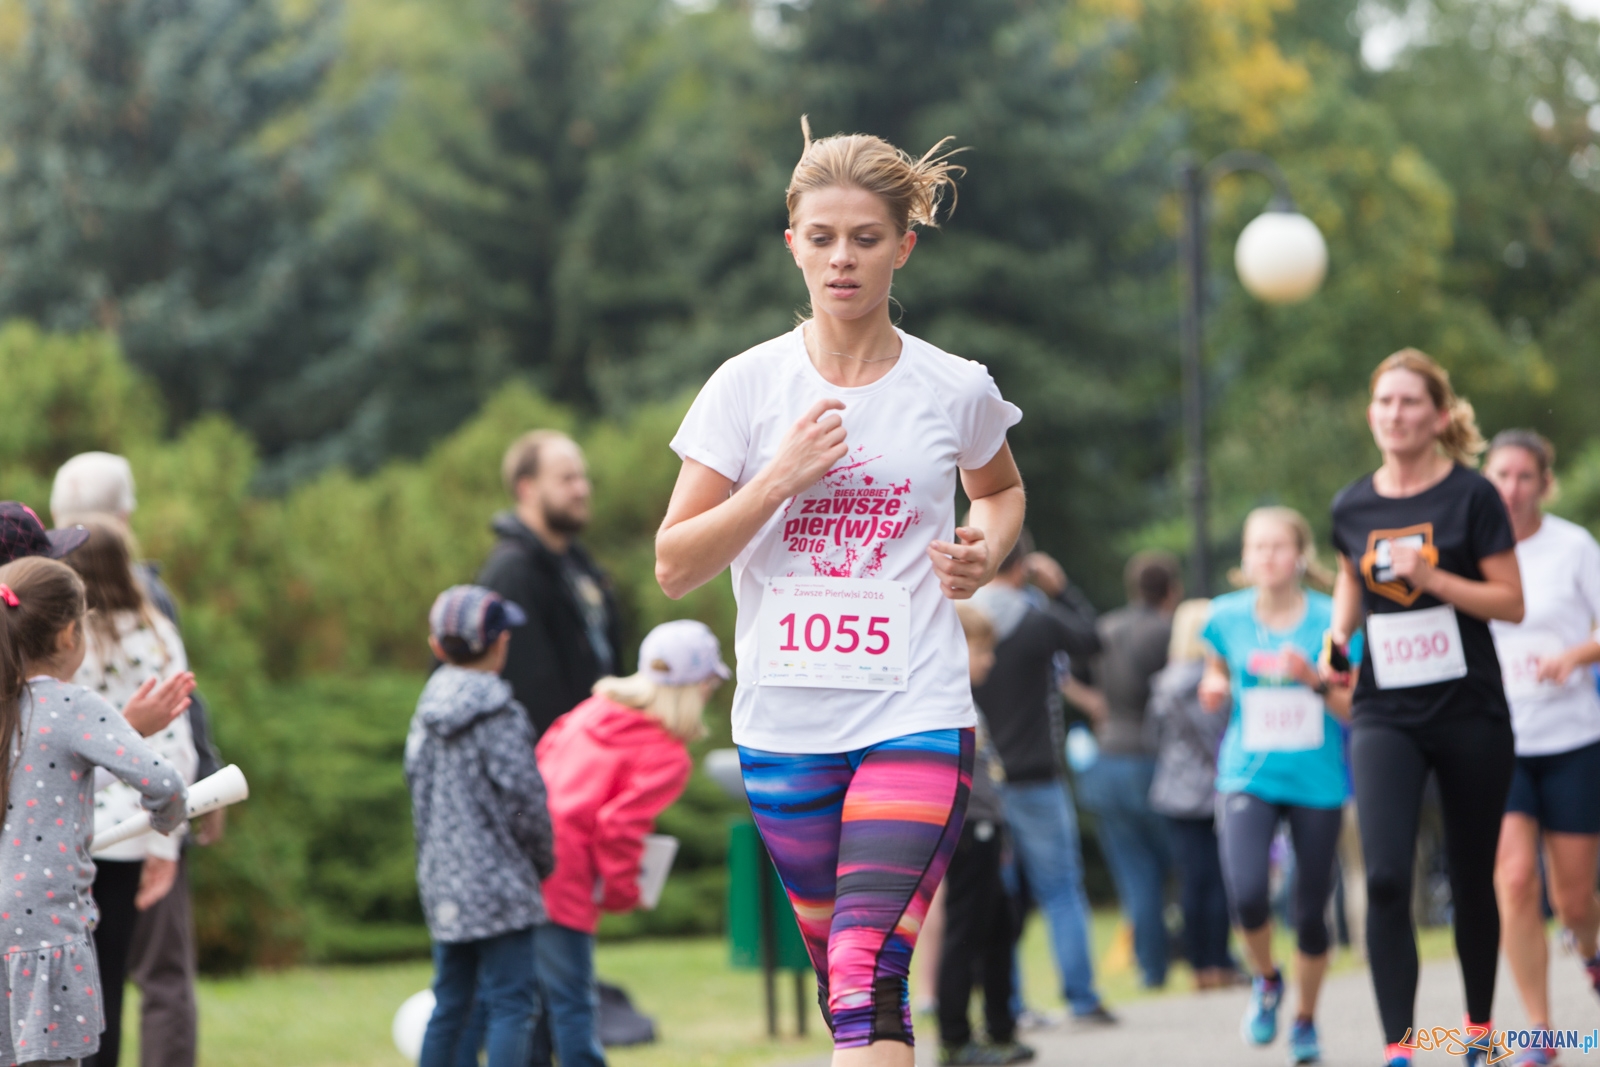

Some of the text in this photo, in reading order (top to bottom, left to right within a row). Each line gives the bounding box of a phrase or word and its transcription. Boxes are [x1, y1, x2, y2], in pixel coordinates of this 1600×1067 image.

[833, 488, 890, 498] BIEG KOBIET
[800, 498, 901, 516] zawsze
[788, 537, 826, 553] 2016
[794, 588, 823, 597] Zawsze
[825, 589, 860, 600] Pier(w)si
[863, 591, 884, 600] 2016
[779, 613, 890, 655] 1055
[1384, 632, 1449, 664] 1030
